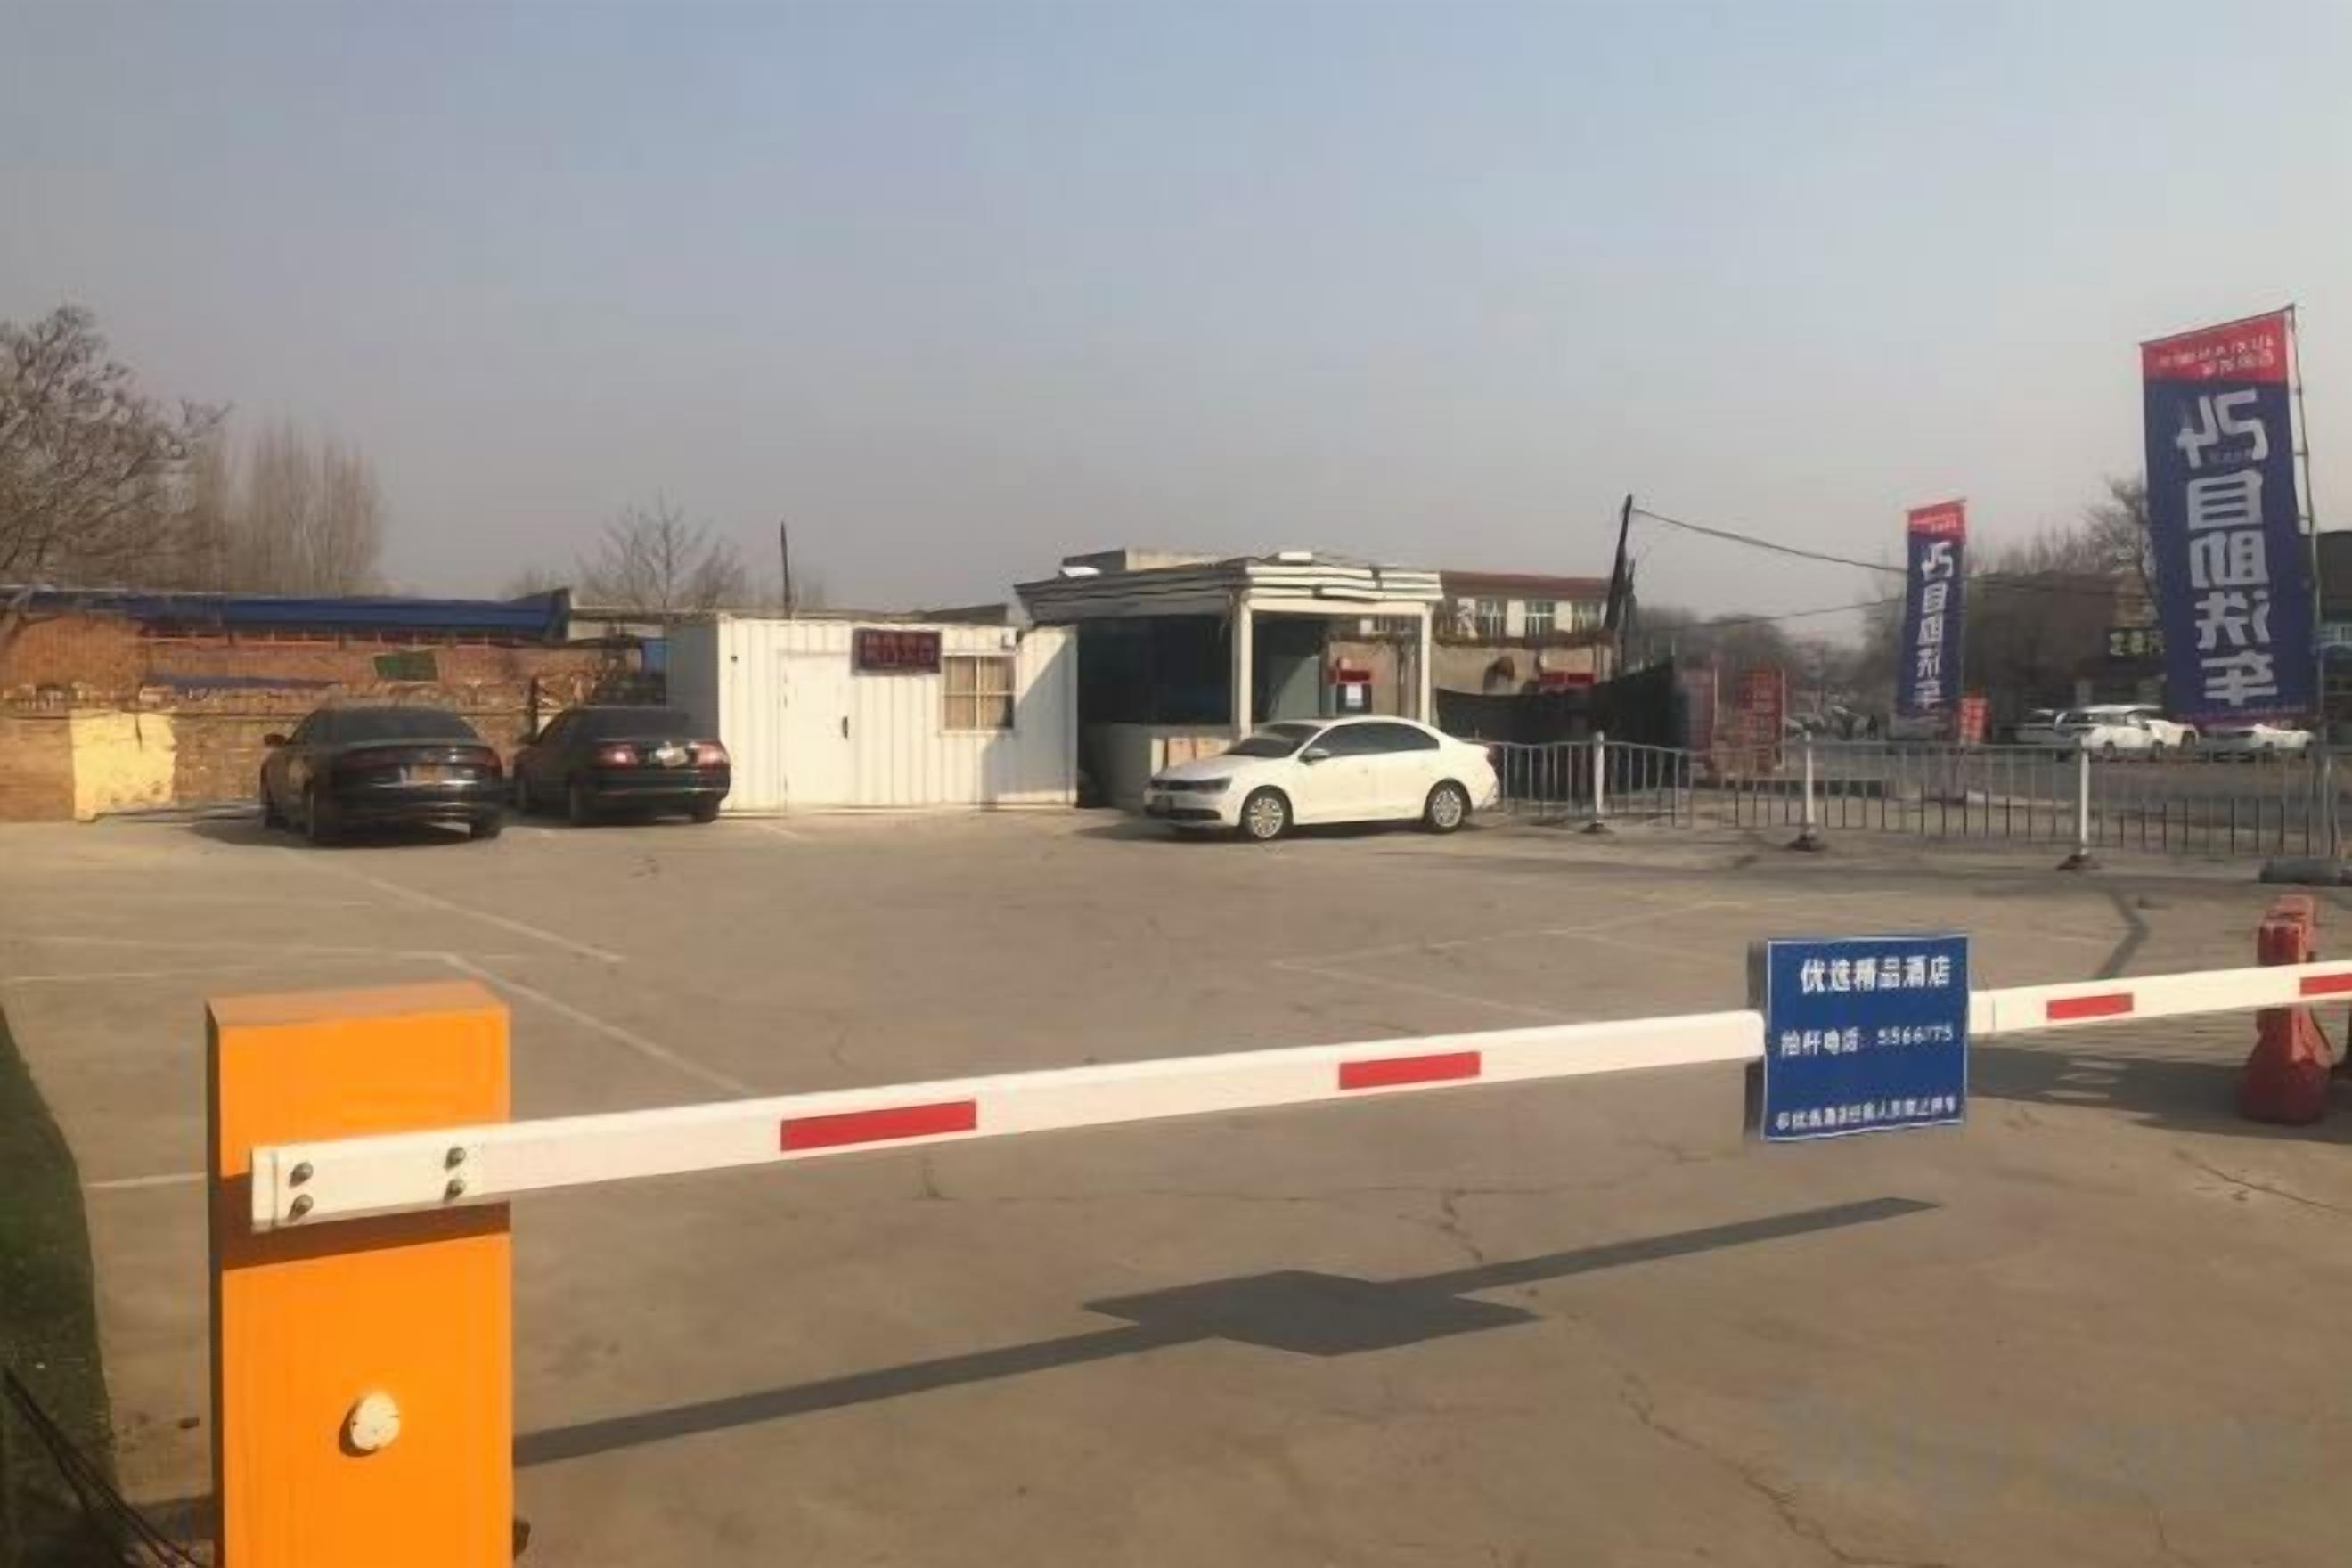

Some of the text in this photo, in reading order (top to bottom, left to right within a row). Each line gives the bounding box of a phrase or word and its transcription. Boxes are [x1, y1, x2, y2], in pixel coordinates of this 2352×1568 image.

[1800, 954, 1951, 994] 优选精品酒店
